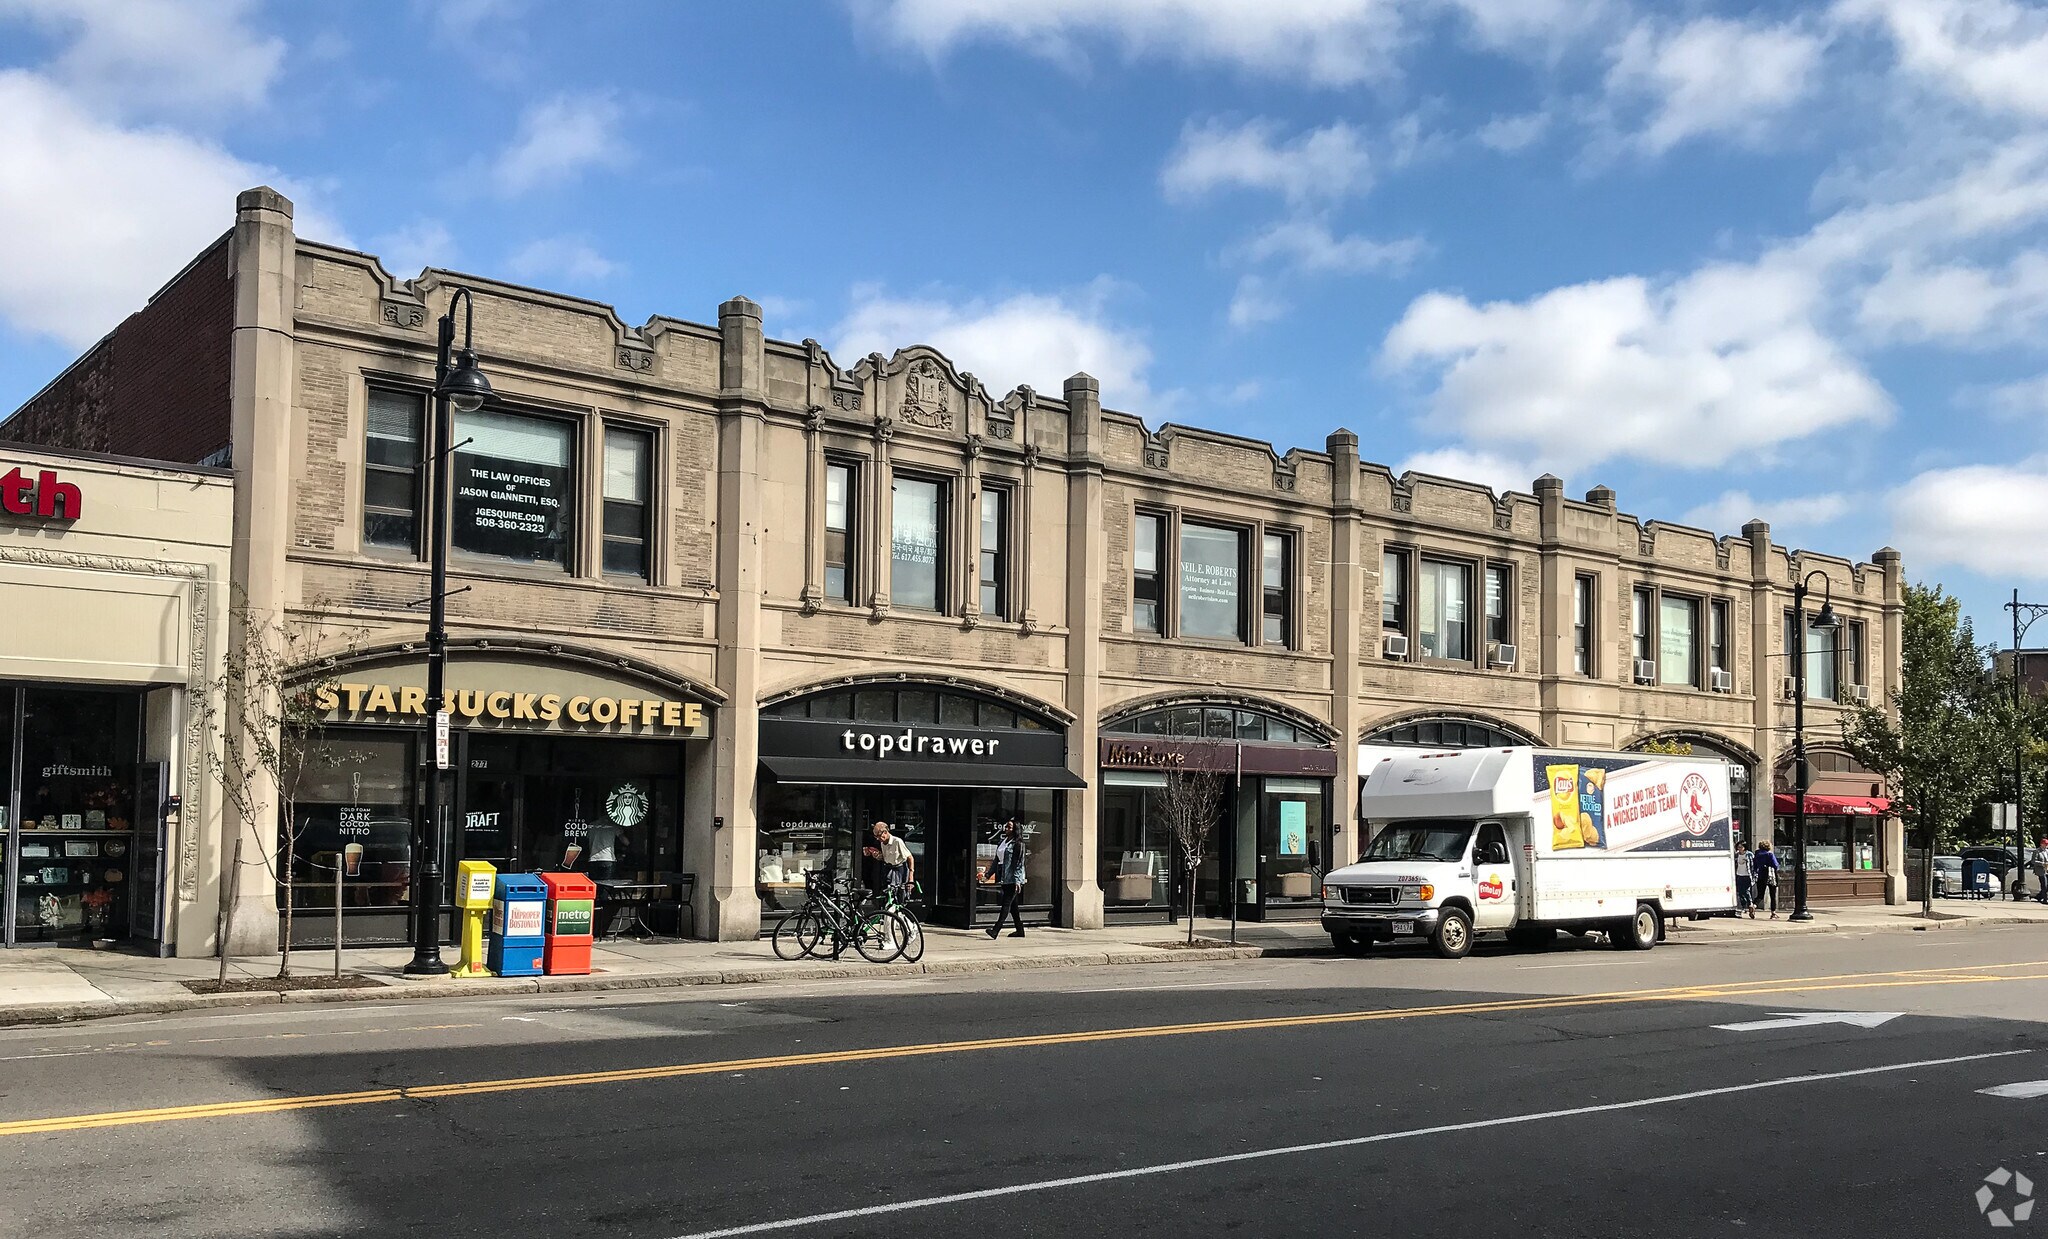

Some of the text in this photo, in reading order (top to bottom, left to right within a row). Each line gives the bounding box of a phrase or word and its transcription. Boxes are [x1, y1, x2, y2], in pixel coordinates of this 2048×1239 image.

[471, 469, 551, 487] THE LAW OFFICES
[0, 467, 81, 519] th
[460, 487, 561, 508] JASON GIANNETTI, ESQ.
[475, 508, 545, 523] JGESQUIRE.COM
[476, 518, 545, 533] 508-360-2323
[1181, 561, 1197, 573] NEIL
[1206, 565, 1237, 578] ROBERTS
[1185, 575, 1210, 586] Attorney
[315, 682, 702, 727] STARBUCKS COFFEE
[842, 729, 999, 758] topdrawer
[42, 765, 112, 778] giftsmith
[1683, 776, 1708, 794] BOSTON
[1614, 794, 1630, 809] LAY'S
[1633, 790, 1644, 804] AND
[1645, 786, 1656, 800] THE
[340, 812, 370, 821] DARK
[1607, 794, 1678, 829] A WICKED GOOD TEAM!
[781, 820, 832, 829] topdrawer
[993, 823, 1037, 831] topwer
[1684, 812, 1709, 830] RED SOX
[512, 910, 541, 920] IMPROPER
[559, 910, 591, 920] metro
[509, 919, 540, 929] BOSTONIAN
